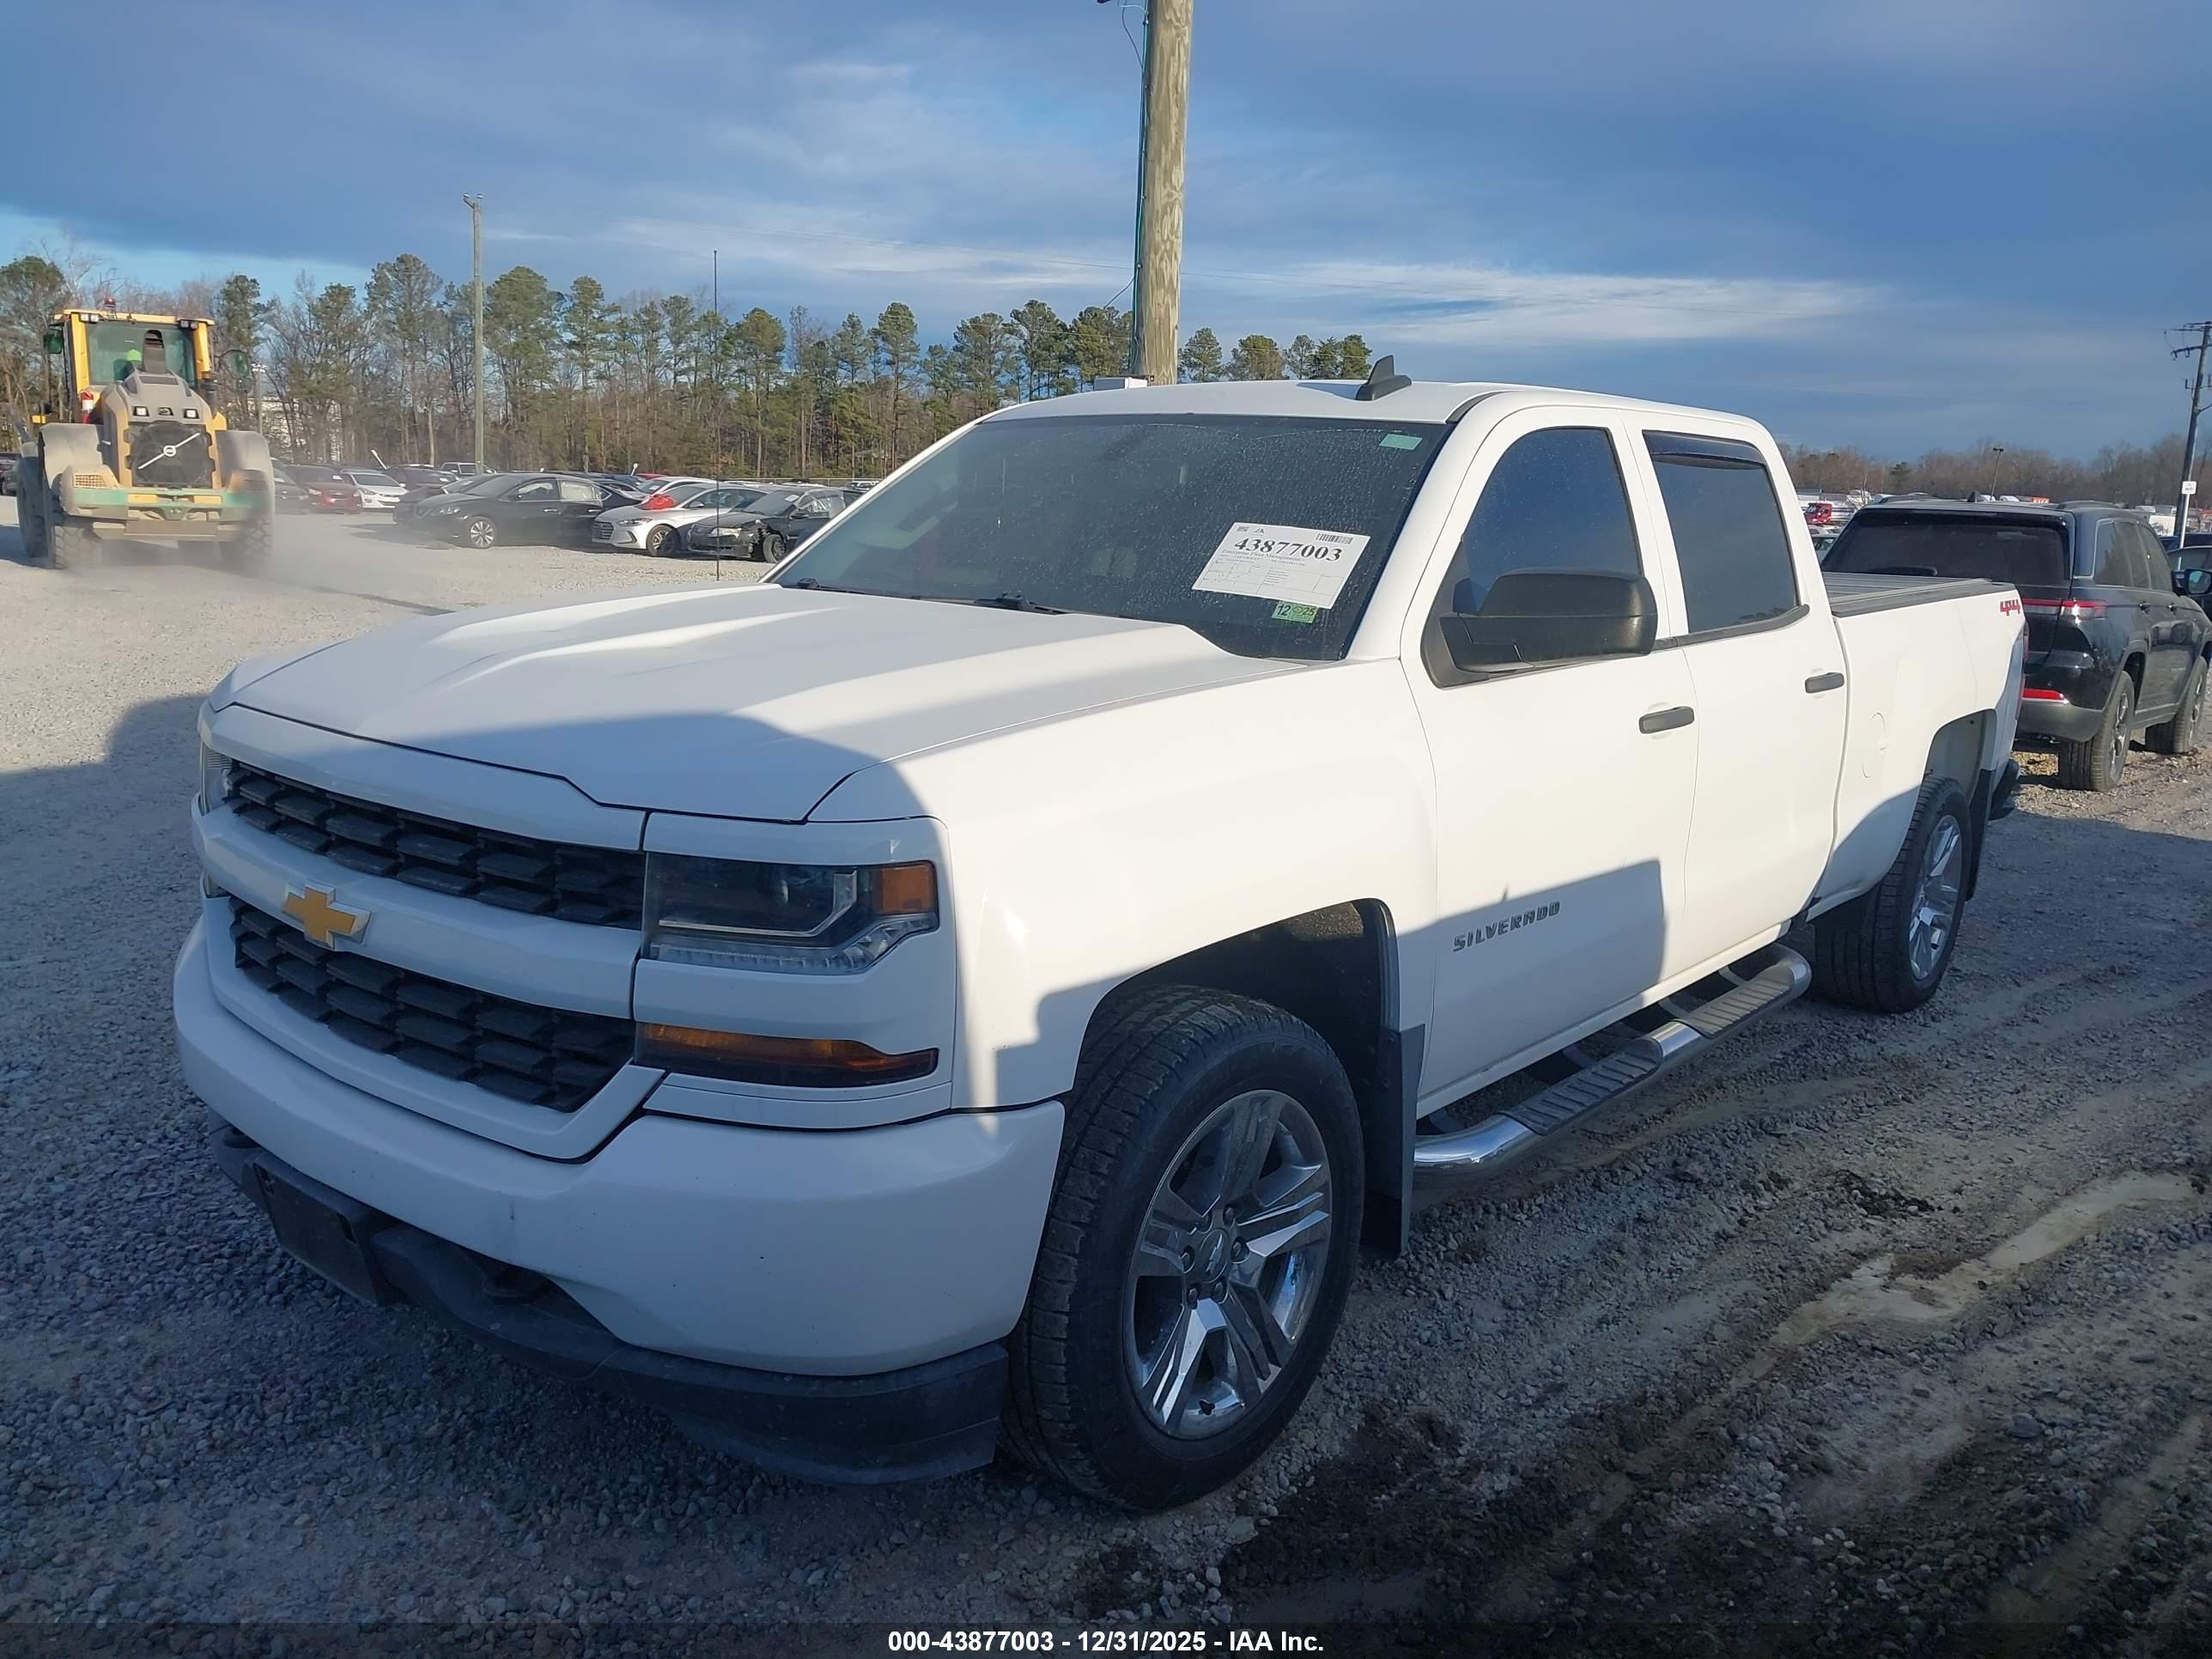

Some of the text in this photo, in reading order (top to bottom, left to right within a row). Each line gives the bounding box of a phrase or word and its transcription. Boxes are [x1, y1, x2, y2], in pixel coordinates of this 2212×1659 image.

[1234, 538, 1343, 562] 43877003
[1277, 604, 1316, 617] 12 25
[1452, 900, 1560, 952] SILVERADO
